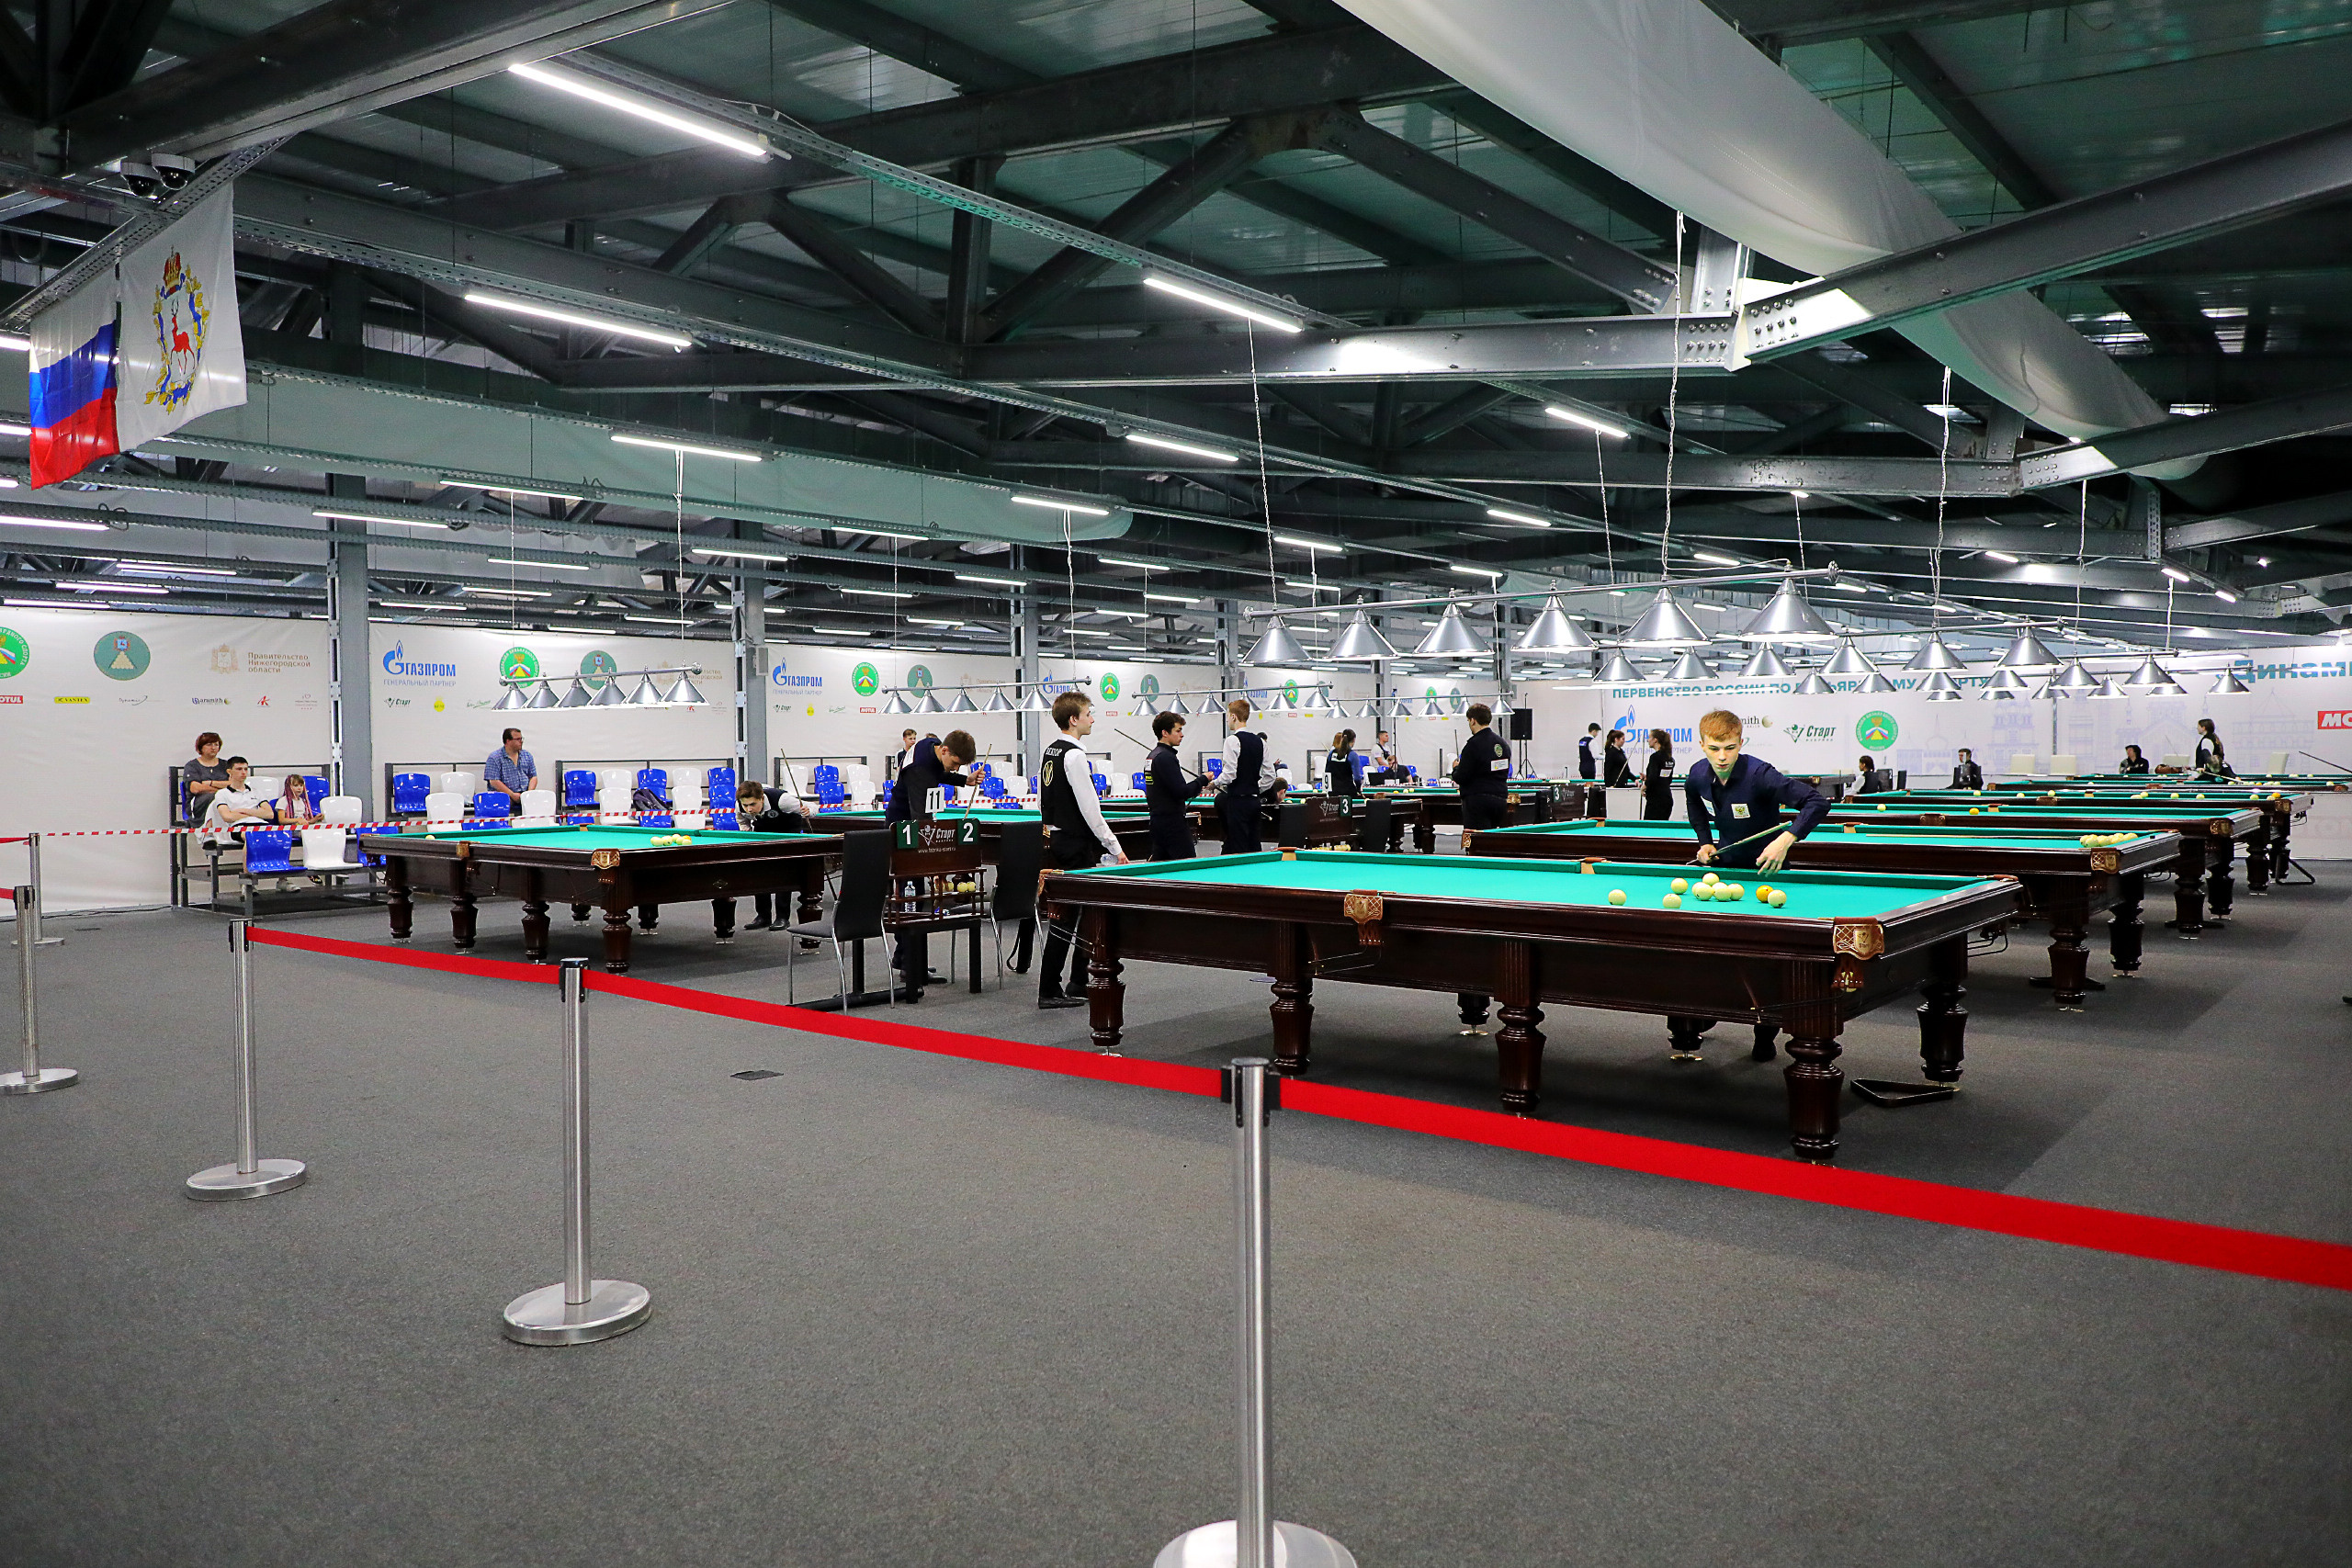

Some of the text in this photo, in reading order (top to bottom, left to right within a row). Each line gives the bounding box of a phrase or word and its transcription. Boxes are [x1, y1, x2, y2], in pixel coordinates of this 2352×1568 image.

[248, 652, 309, 660] Правительство
[406, 662, 456, 677] ГАЗПРОМ
[383, 679, 429, 687] ГЕНЕРАЛЬНЫЙ
[788, 675, 822, 687] ГАЗПРОМ
[1806, 726, 1836, 739] Старт
[1324, 774, 1329, 790] 9
[929, 790, 941, 810] 11
[1555, 787, 1560, 800] 3
[1342, 798, 1349, 814] 3
[902, 824, 911, 845] 1
[936, 828, 956, 840] Старт
[963, 822, 974, 842] 2
